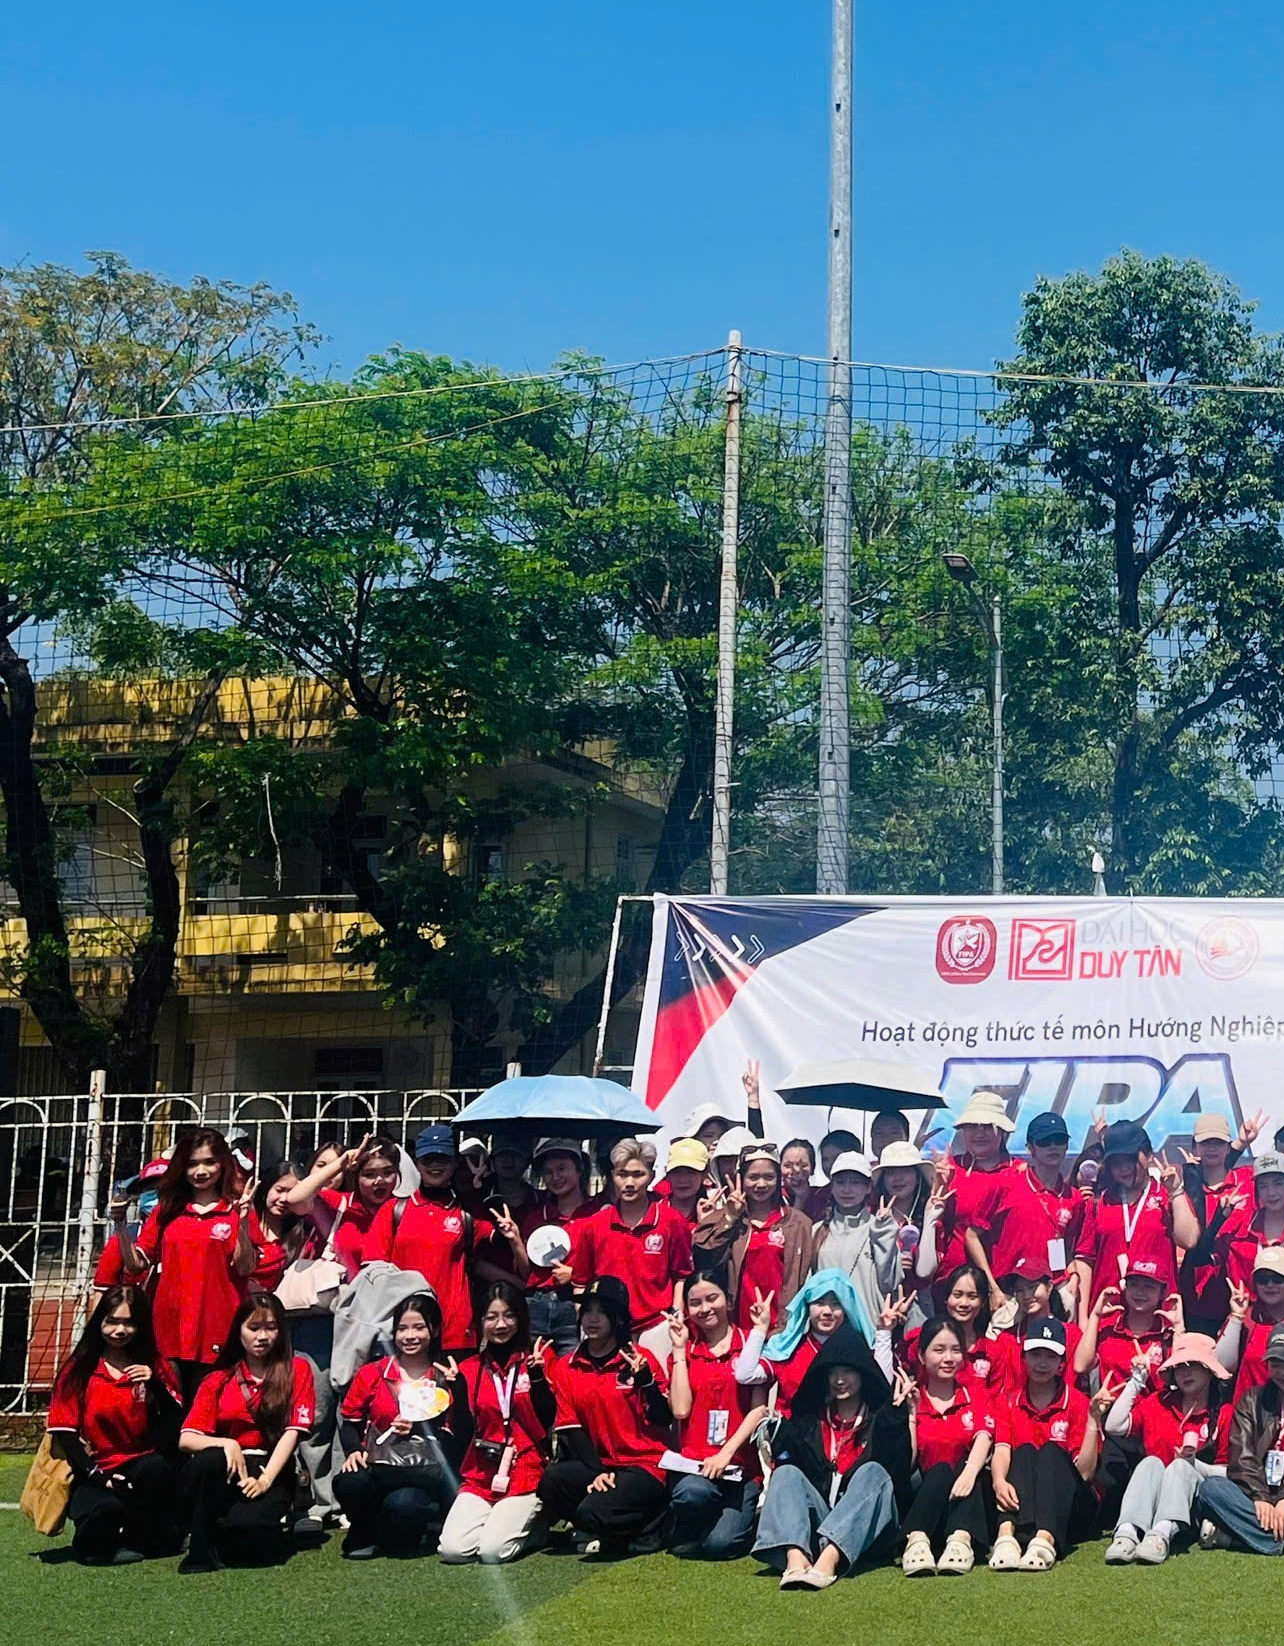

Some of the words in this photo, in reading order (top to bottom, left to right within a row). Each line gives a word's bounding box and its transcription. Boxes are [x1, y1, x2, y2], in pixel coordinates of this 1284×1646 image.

[1079, 950, 1128, 979] DUY
[1133, 944, 1182, 978] TÂN
[862, 1020, 915, 1047] Hoạt
[922, 1020, 978, 1048] động
[986, 1020, 1035, 1042] thức
[1042, 1014, 1065, 1040] tế
[1072, 1019, 1120, 1040] môn
[1129, 1017, 1202, 1043] Hướng
[914, 1053, 1254, 1164] FIPA
